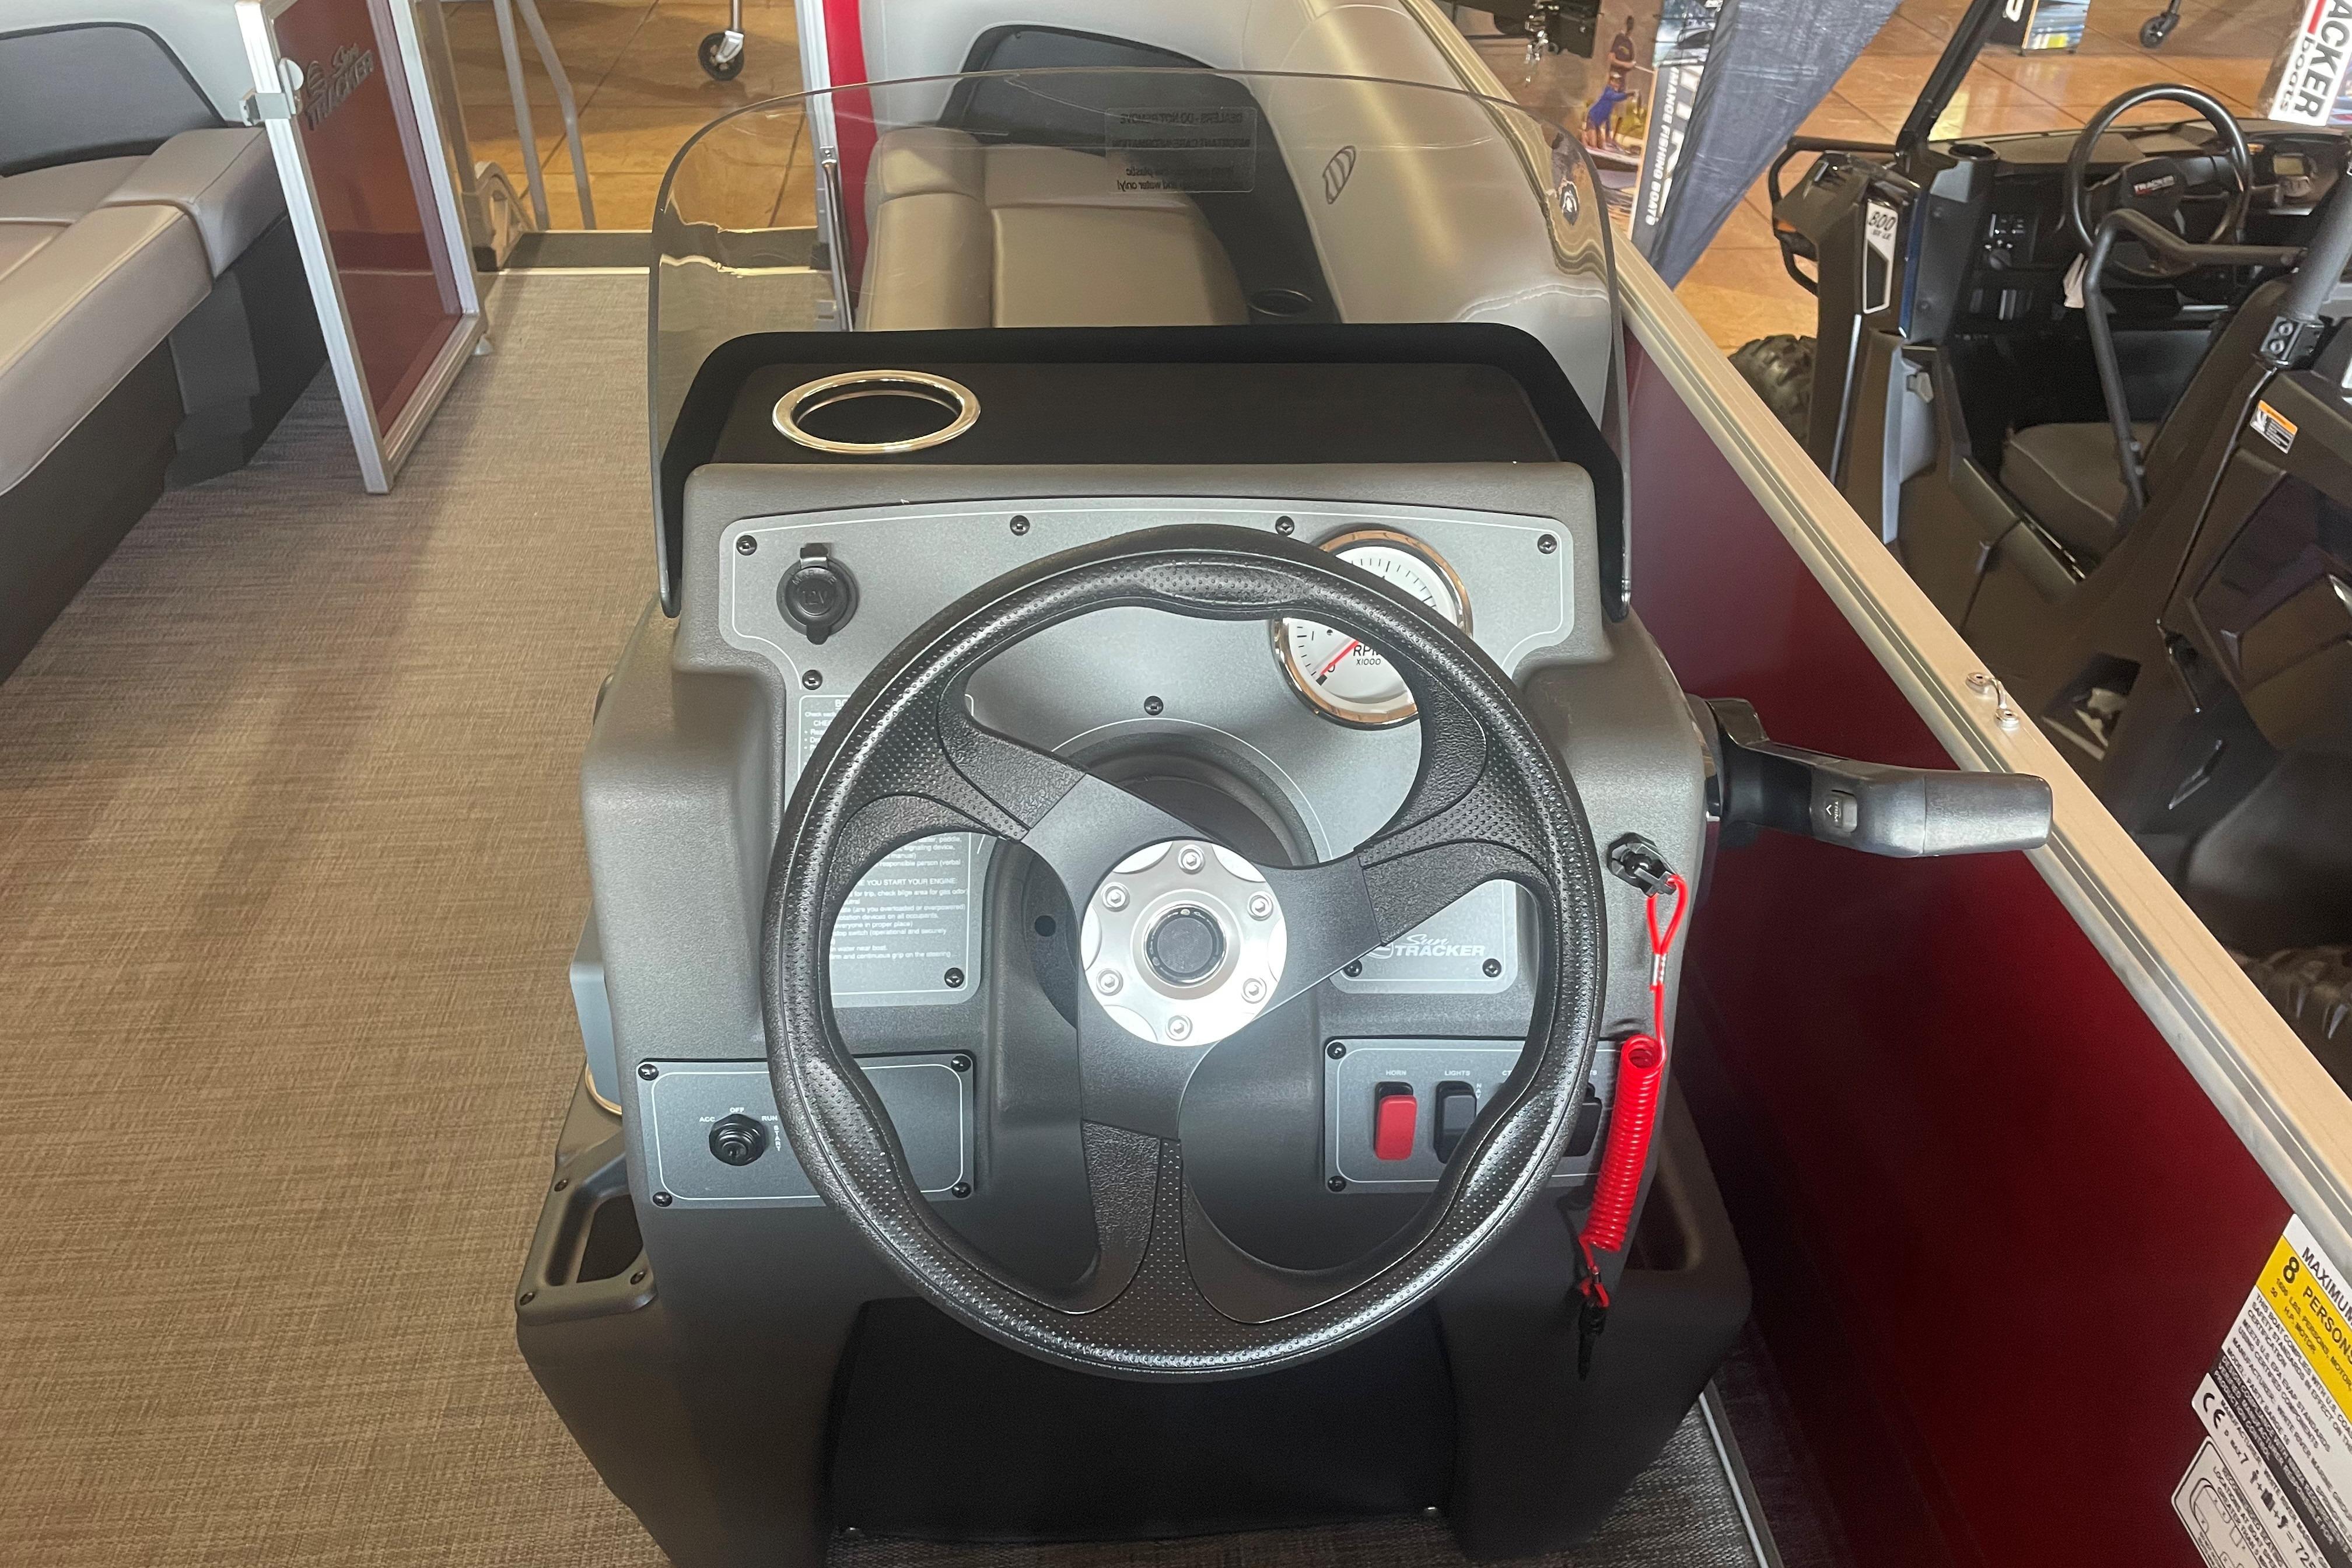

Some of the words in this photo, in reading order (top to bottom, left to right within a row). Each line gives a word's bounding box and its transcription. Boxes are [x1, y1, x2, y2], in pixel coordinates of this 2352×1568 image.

[1395, 945, 1486, 957] TRACKER
[1400, 933, 1450, 946] Sun
[2283, 1256, 2300, 1283] 8
[2248, 1310, 2286, 1367] CERTIFICATION
[2256, 1293, 2268, 1312] THIS
[2267, 1311, 2284, 1334] BOAT
[2283, 1334, 2311, 1376] COMPLIES
[2311, 1374, 2326, 1397] WITH
[2242, 1319, 2260, 1346] MEETS
[2270, 1361, 2281, 1380] EPA
[2296, 1401, 2330, 1452] STANDARDS
[2252, 1301, 2273, 1331] SAFETY
[2272, 1331, 2305, 1380] STANDARDS
[2311, 1389, 2334, 1420] EFFECT
[2332, 1421, 2342, 1436] ON
[2254, 1351, 2281, 1391] CERTIFIED
[2281, 1391, 2318, 1448] COMPONENTS
[2240, 1452, 2249, 1464] 7
[2294, 1432, 2311, 1458] RIVER
